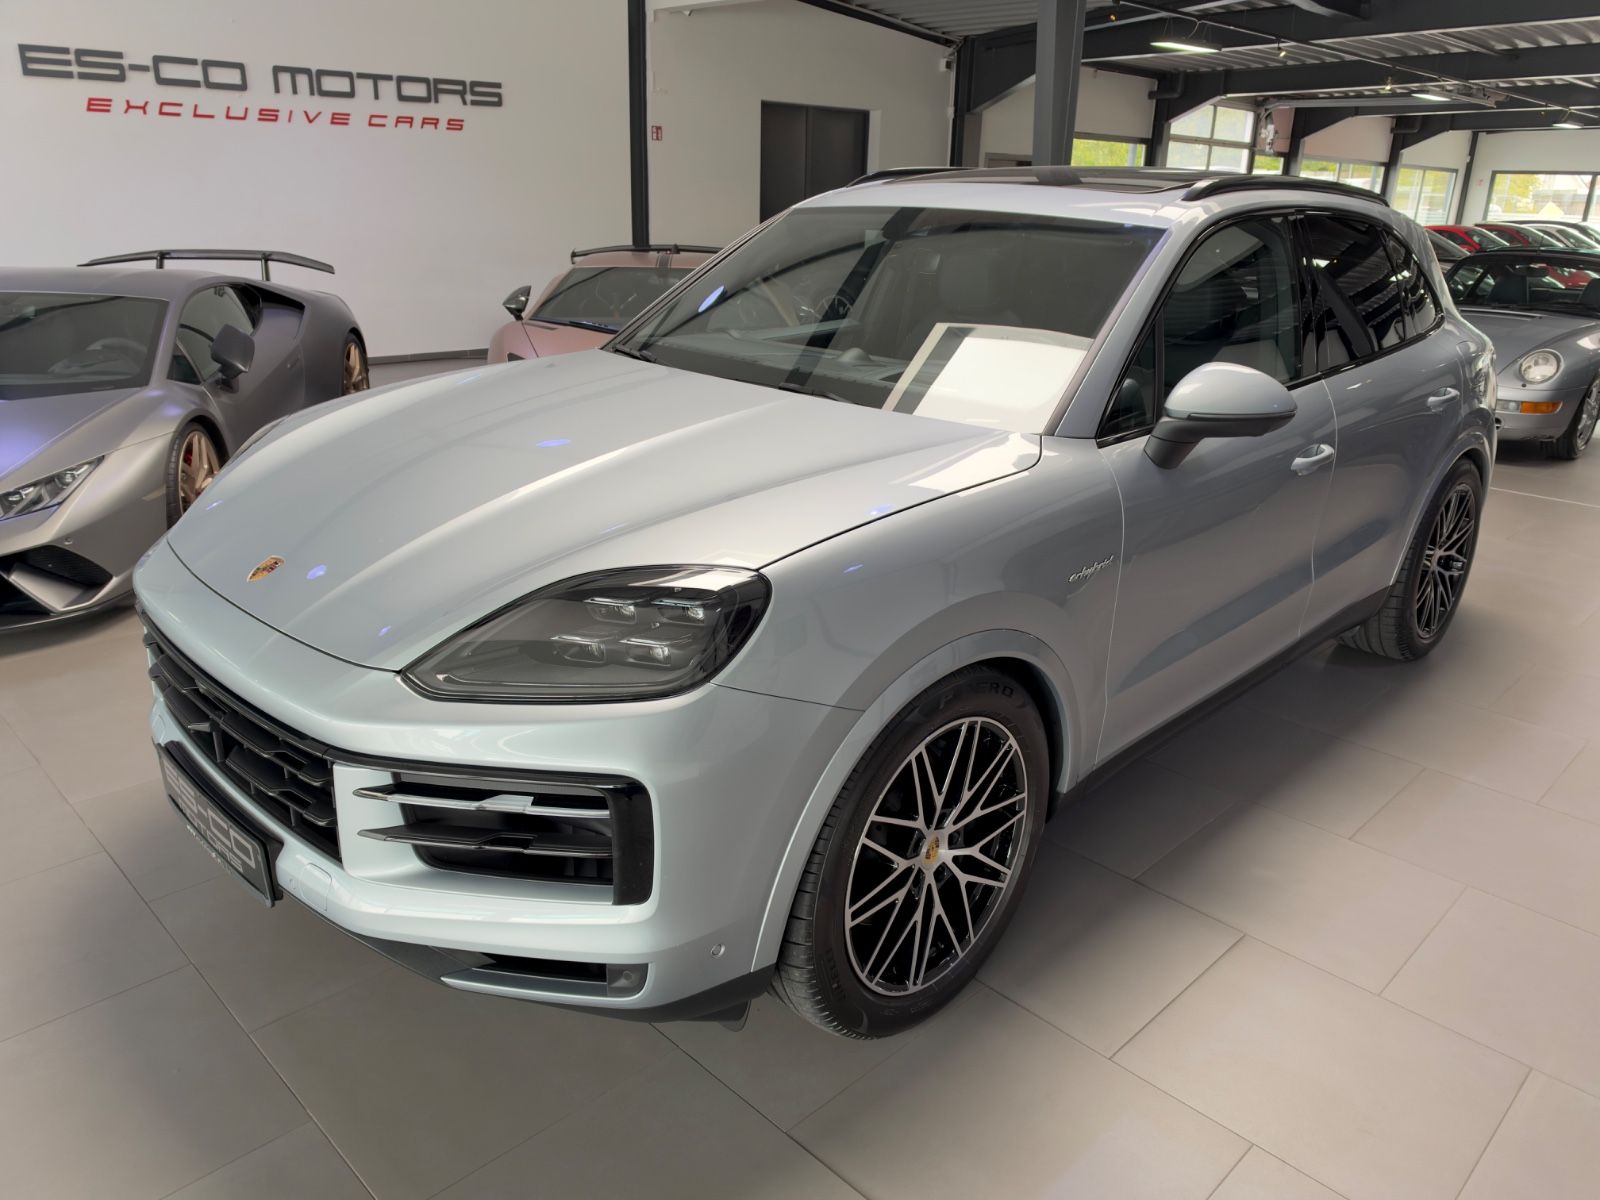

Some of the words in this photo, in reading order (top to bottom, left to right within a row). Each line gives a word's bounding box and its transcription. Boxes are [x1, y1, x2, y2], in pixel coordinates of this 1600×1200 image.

[18, 43, 248, 92] ES-CO
[272, 65, 503, 107] MOTORS
[86, 97, 352, 126] EXCLUSIVE
[368, 114, 465, 131] CARS
[162, 758, 256, 870] ES-CO
